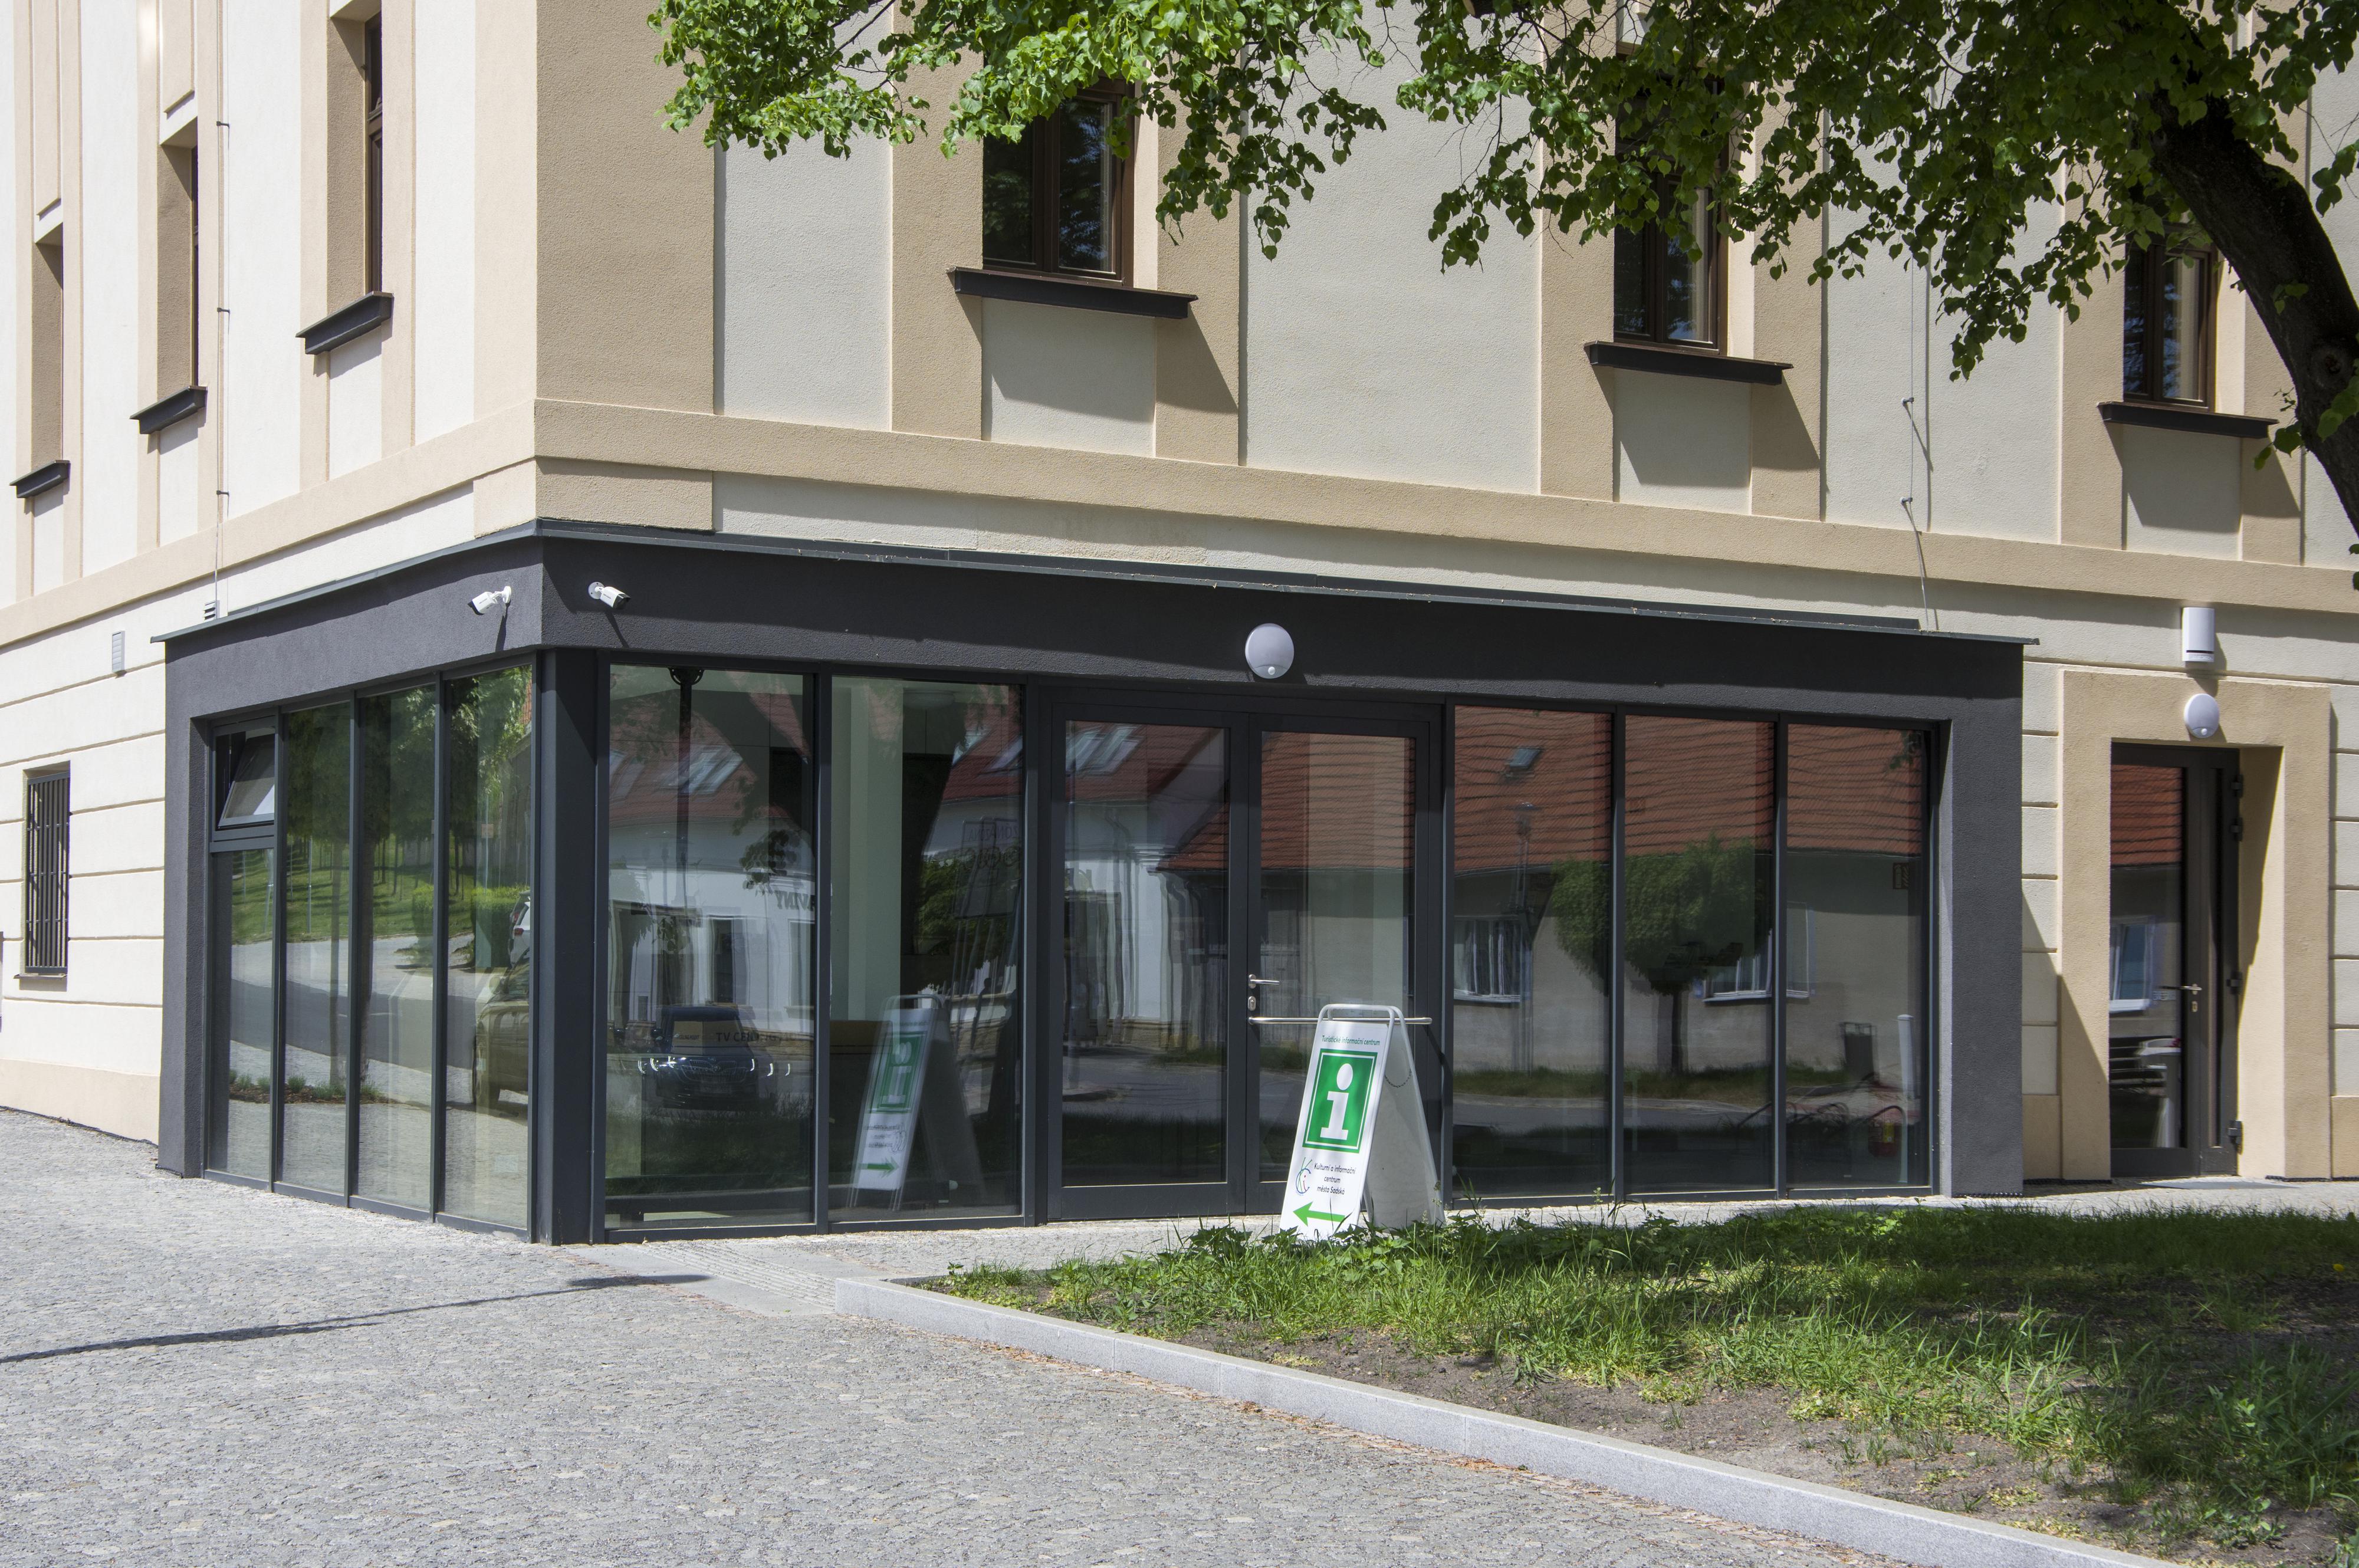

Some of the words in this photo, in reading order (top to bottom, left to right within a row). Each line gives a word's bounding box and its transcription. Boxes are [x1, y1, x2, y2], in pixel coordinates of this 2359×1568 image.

[716, 1032, 730, 1043] TV
[1322, 1035, 1341, 1043] Turistické
[1341, 1037, 1364, 1045] informační
[1314, 1163, 1330, 1172] Kulturní
[1334, 1165, 1356, 1175] informační
[1316, 1185, 1329, 1193] města
[1330, 1186, 1345, 1195] Sadská
